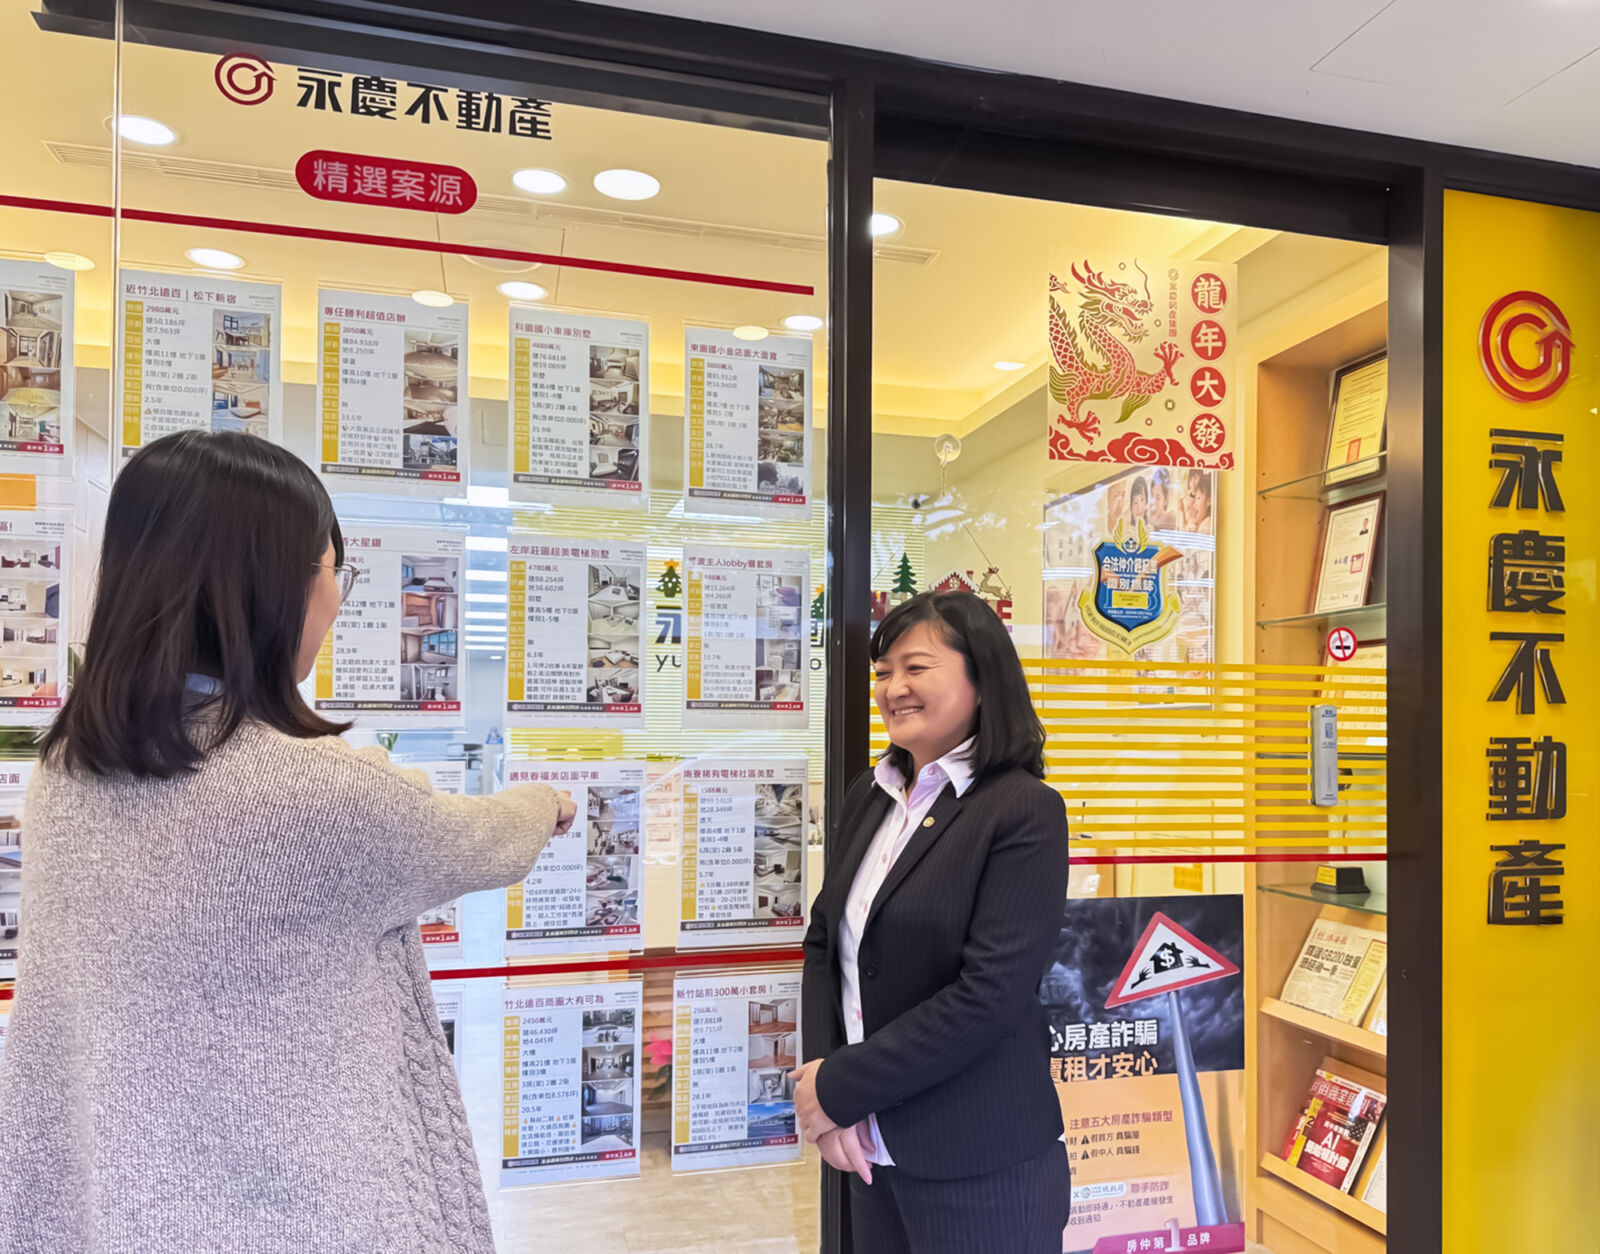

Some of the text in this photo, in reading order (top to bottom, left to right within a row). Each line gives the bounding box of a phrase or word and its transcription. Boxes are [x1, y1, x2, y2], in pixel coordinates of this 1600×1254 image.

[297, 67, 552, 140] 永慶不動產
[312, 158, 464, 206] 精選案源
[515, 322, 591, 339] 科園國小車庫別墅
[1192, 277, 1224, 450] 龍年大發
[510, 545, 610, 559] 左岸莊園超美電梯別墅
[1486, 427, 1567, 926] 永慶不動產
[510, 771, 599, 781] 遇見春福美店面平車
[684, 769, 775, 779] 南寮稀有電梯社區美墅
[504, 994, 604, 1010] 竹北遠百商圈大有可為
[1049, 1019, 1158, 1052] 心房產詐騙
[1070, 1110, 1173, 1131] 注意五大房產詐騙類型
[1321, 1131, 1340, 1151] AI
